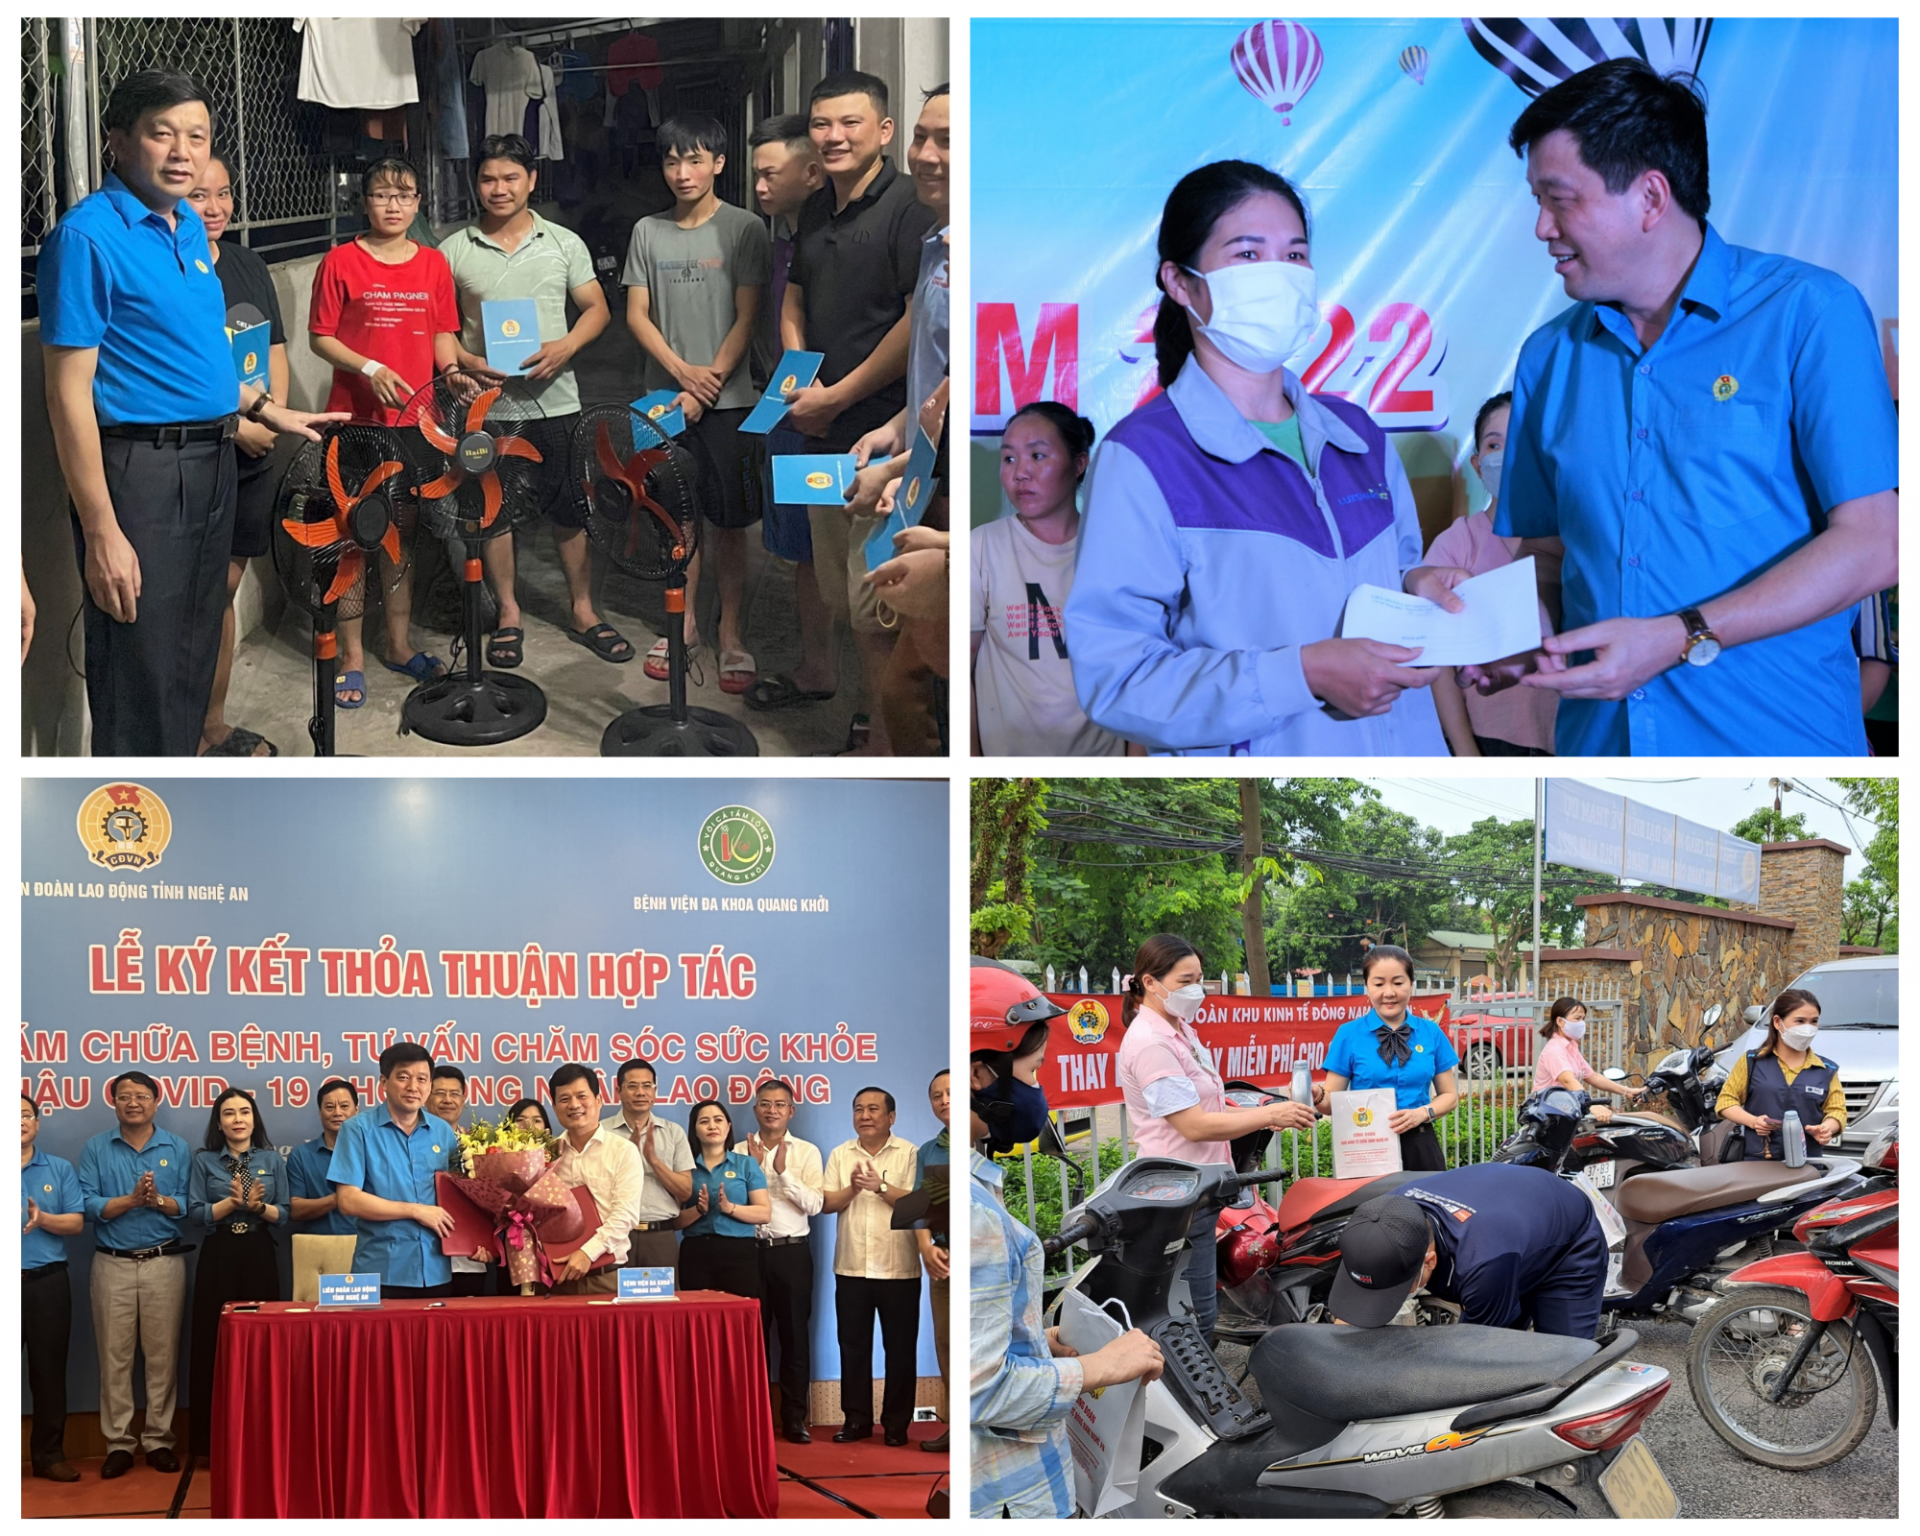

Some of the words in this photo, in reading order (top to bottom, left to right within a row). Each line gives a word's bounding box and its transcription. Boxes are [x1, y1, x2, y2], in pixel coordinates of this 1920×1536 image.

[363, 291, 391, 300] CHAM
[1006, 603, 1026, 612] Well
[1028, 603, 1034, 611] it
[1036, 604, 1061, 613] black
[1006, 612, 1026, 620] Well
[1028, 612, 1034, 620] it
[1006, 621, 1026, 629] Well
[1036, 621, 1063, 629] black
[1007, 630, 1028, 638] Aww
[110, 854, 142, 866] CĐVN
[709, 861, 741, 881] QUANG
[34, 879, 74, 898] ĐOÀN
[78, 882, 105, 899] LAO
[108, 881, 148, 902] ĐỘNG
[151, 880, 184, 900] TỈNH
[188, 883, 225, 904] NGHỆ
[229, 886, 249, 901] AN
[633, 894, 667, 914] BỆNH
[670, 894, 698, 914] VIỆN
[701, 897, 718, 911] ĐA
[721, 898, 754, 912] KHOA
[757, 899, 798, 913] QUANG
[801, 895, 829, 912] KHỞI
[89, 928, 145, 995] LỄ
[156, 936, 217, 995] KÝ
[227, 933, 309, 996] KẾT
[319, 934, 432, 997] THỎA
[440, 942, 577, 1008] THUẬN
[587, 949, 670, 1008] HỢP
[678, 944, 756, 999] TÁC
[1232, 1006, 1260, 1023] KHU
[1263, 1006, 1294, 1023] KINH
[1296, 1001, 1309, 1022] TẾ
[1312, 1002, 1346, 1021] ĐÔNG
[80, 1024, 199, 1064] CHỮA
[209, 1023, 333, 1069] BỆNH,
[492, 1025, 600, 1064] CHĂM
[609, 1026, 686, 1064] SÓC
[695, 1026, 769, 1064] SỨC
[780, 1021, 878, 1064] KHỎE
[1227, 1034, 1267, 1078] MIỄN
[1269, 1037, 1295, 1075] PHÍ
[1057, 1053, 1109, 1093] THAY
[267, 1076, 311, 1109] 19
[1737, 1205, 1794, 1224] VISION
